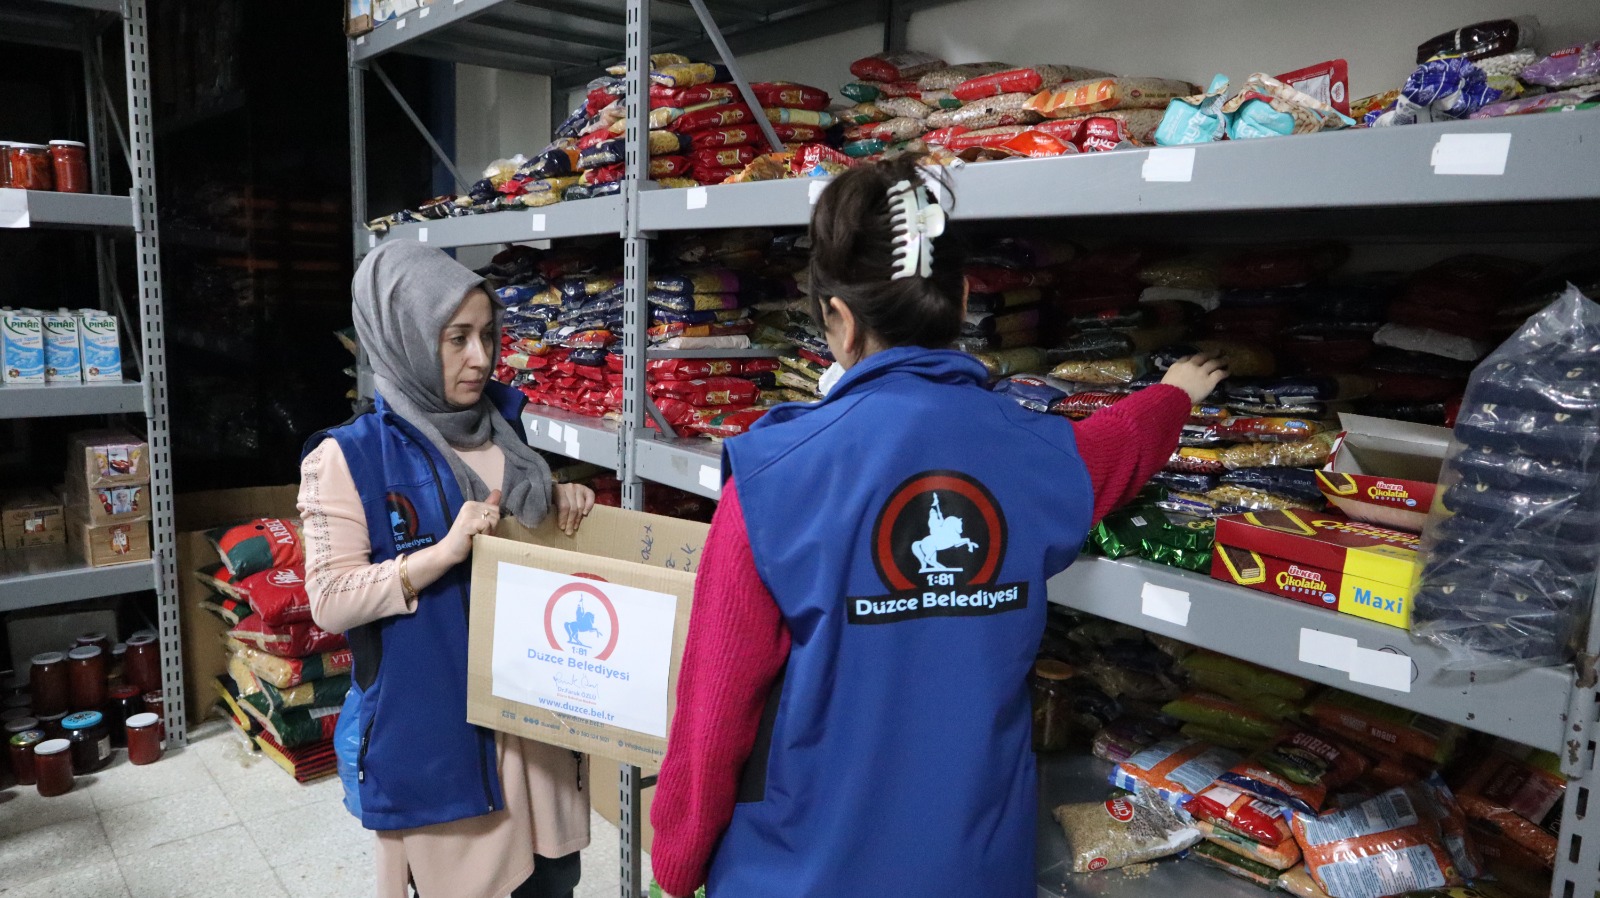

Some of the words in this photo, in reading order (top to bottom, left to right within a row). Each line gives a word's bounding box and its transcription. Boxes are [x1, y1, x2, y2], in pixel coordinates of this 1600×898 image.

[1376, 481, 1404, 491] ÜLKER
[926, 573, 954, 586] 1:81
[1276, 571, 1327, 591] Çikolatalı
[1288, 564, 1321, 582] ÜLKER
[855, 598, 918, 616] Düzce
[922, 586, 1018, 608] Belediyesi
[1354, 587, 1403, 614] Maxi
[572, 646, 588, 656] 1:81
[527, 648, 564, 666] Düzce
[567, 657, 630, 681] Belediyesi
[538, 696, 615, 721] www.duzce.bel.tr
